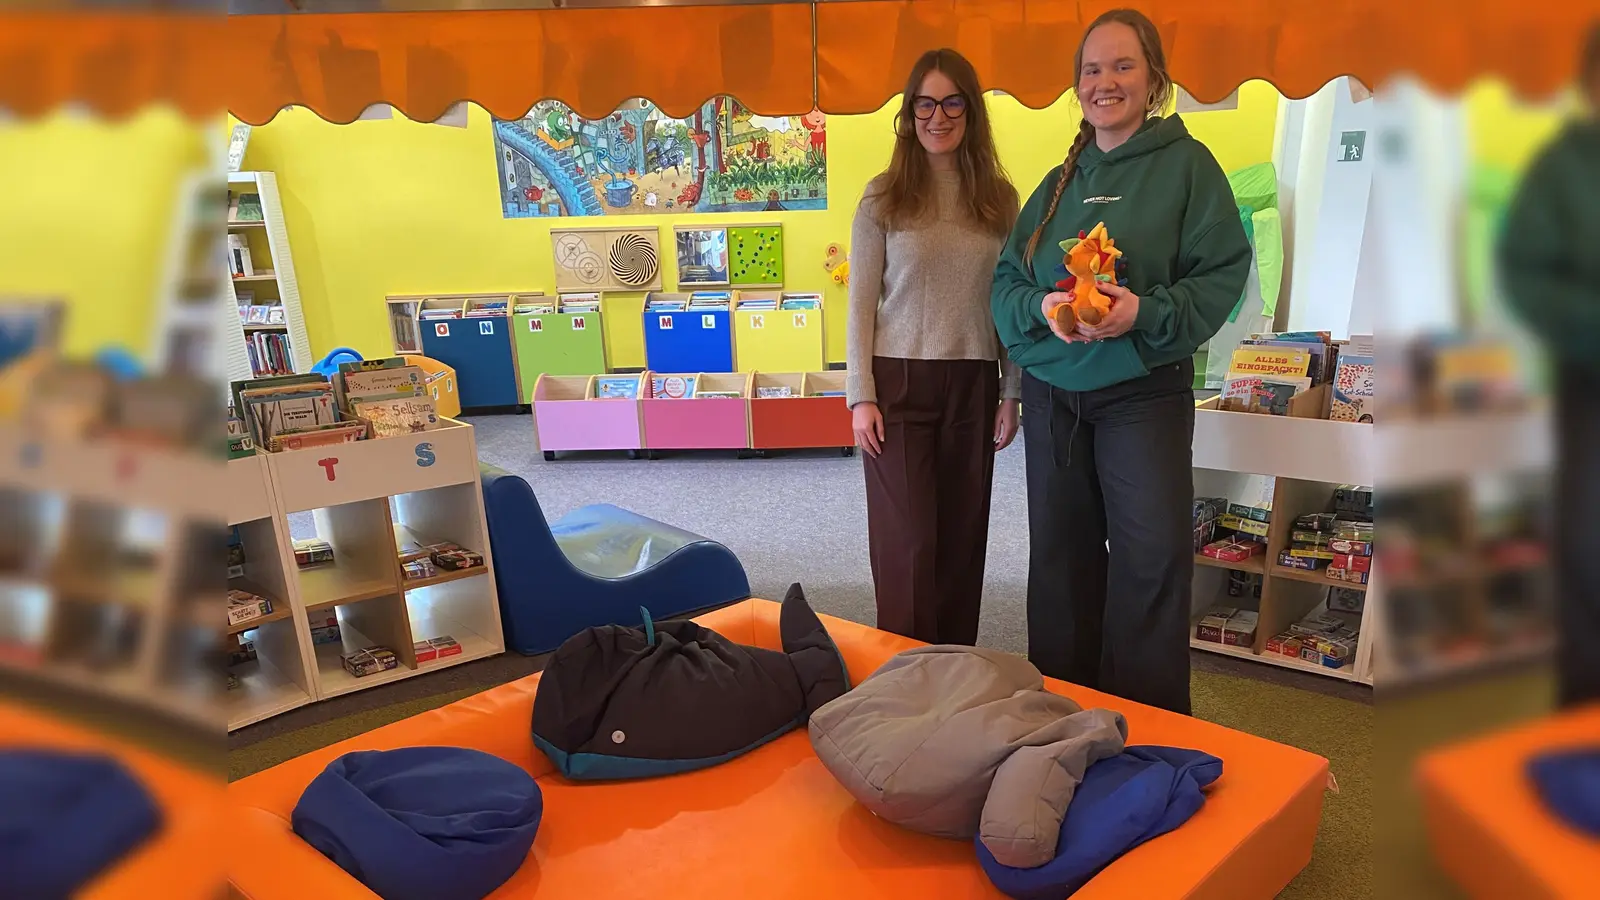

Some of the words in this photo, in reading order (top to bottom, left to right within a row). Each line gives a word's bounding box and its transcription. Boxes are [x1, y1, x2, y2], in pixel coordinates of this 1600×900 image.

[531, 320, 542, 330] M
[573, 318, 585, 329] M
[661, 317, 672, 328] M
[704, 316, 713, 328] L
[752, 316, 763, 328] K
[795, 315, 805, 327] K
[436, 324, 448, 336] O
[481, 322, 492, 334] N
[1254, 356, 1288, 365] ALLES
[1236, 363, 1304, 374] EINGEPACKT!
[409, 372, 418, 382] S
[320, 398, 328, 407] T
[428, 414, 437, 423] S
[243, 439, 252, 449] V
[415, 442, 436, 467] S
[318, 457, 339, 481] T
